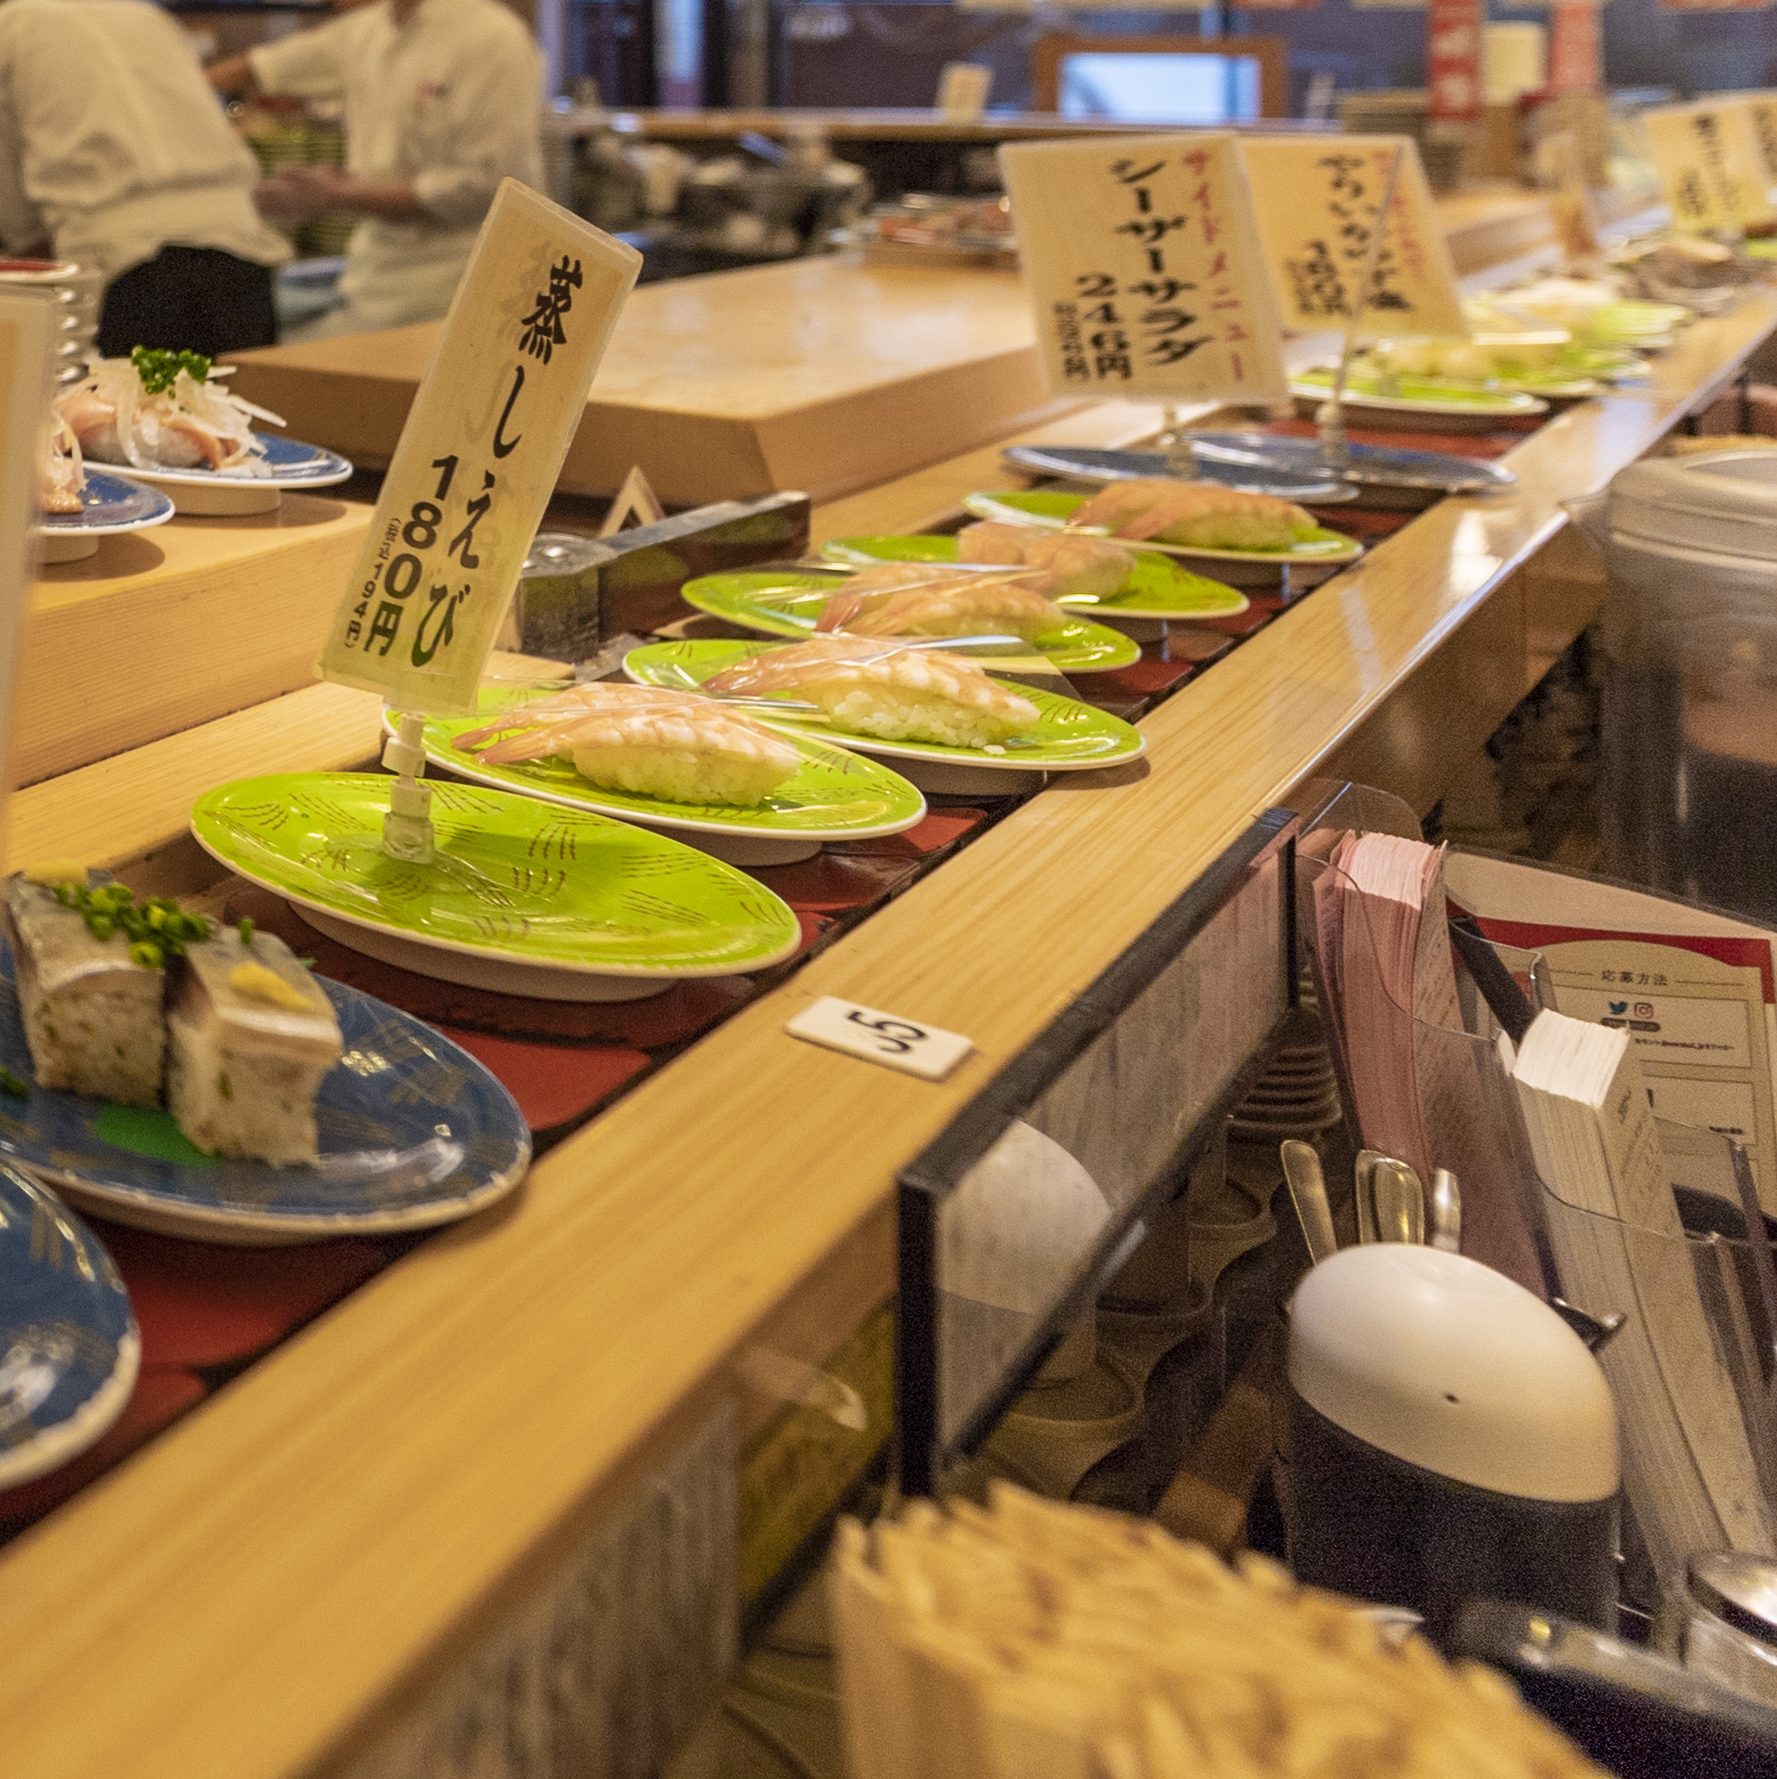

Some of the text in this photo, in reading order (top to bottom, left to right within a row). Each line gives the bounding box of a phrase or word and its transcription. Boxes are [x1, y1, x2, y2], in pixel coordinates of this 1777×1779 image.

[1108, 157, 1215, 367] シーザーサラダ
[364, 454, 458, 657] 180円
[410, 254, 583, 668] 蒸しえび
